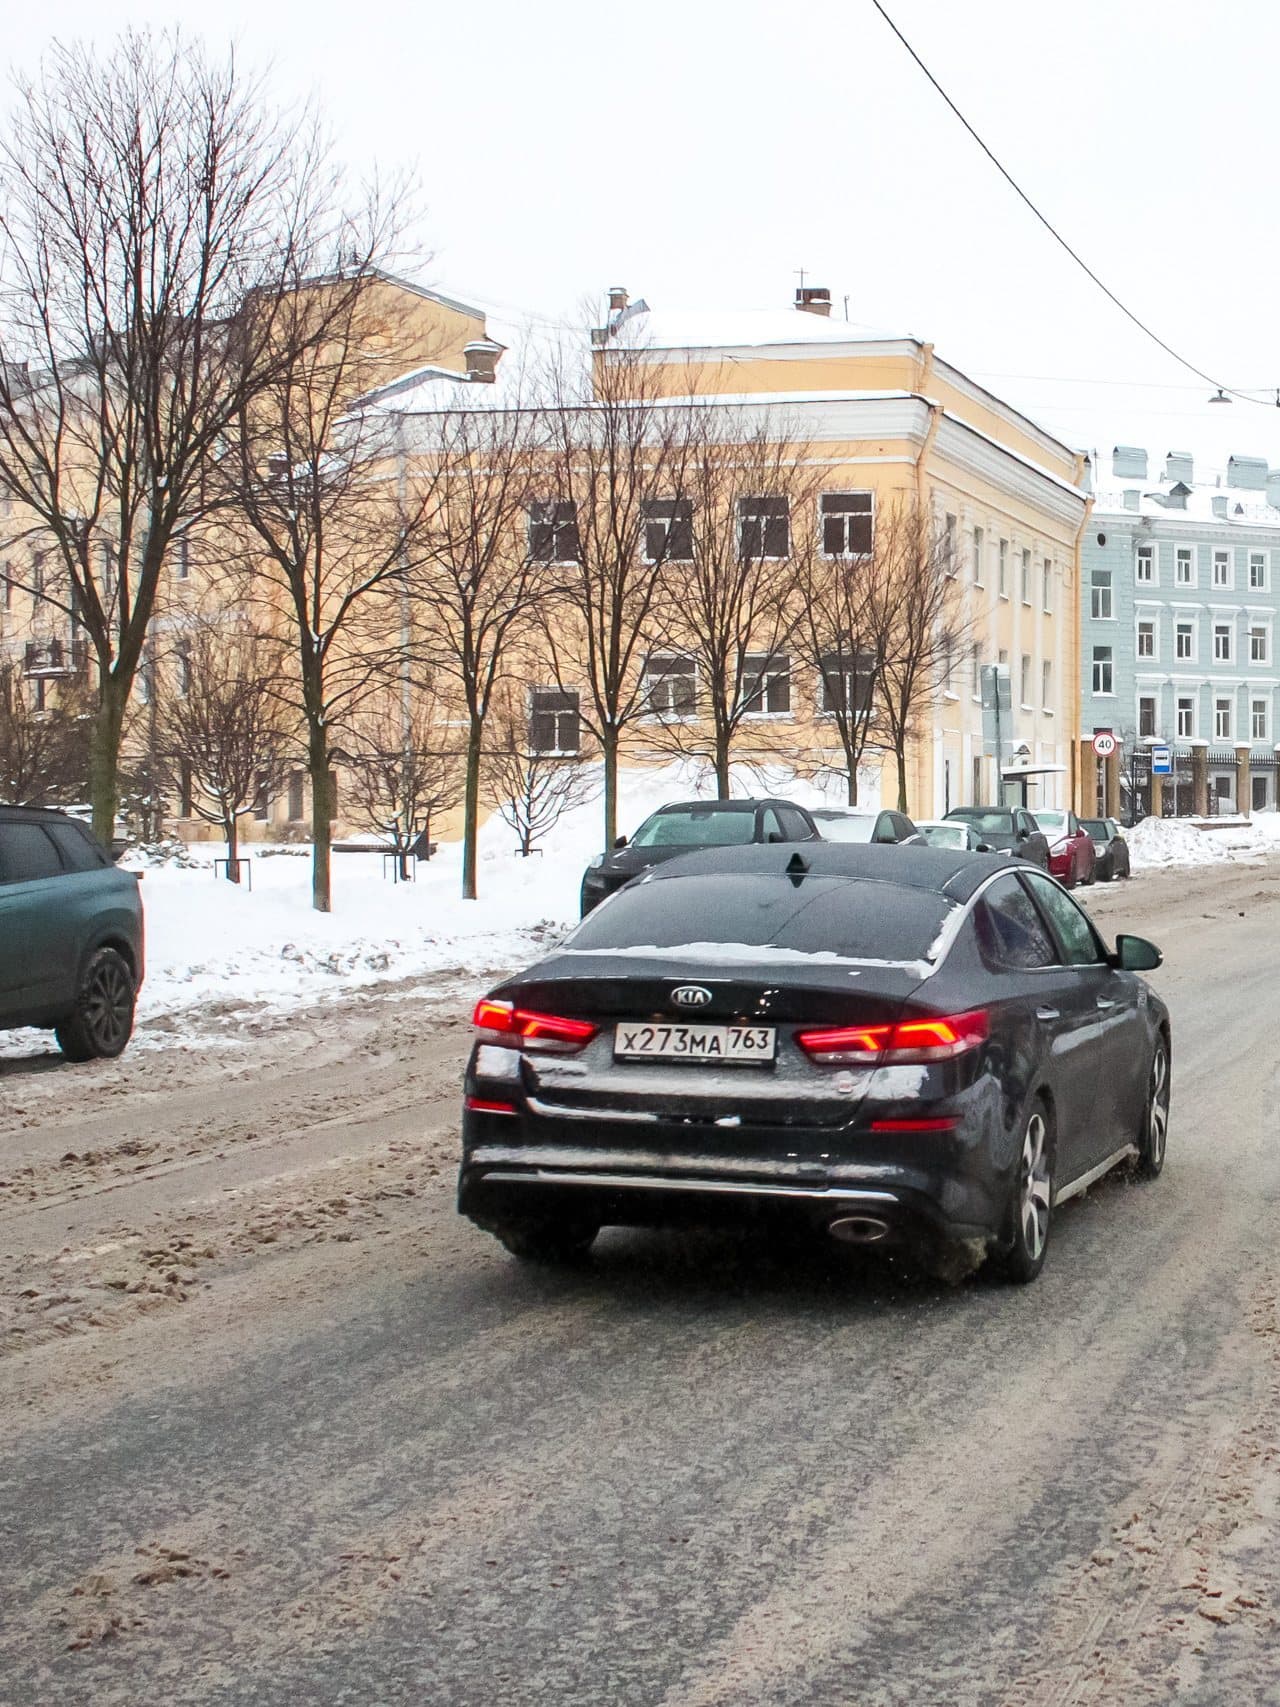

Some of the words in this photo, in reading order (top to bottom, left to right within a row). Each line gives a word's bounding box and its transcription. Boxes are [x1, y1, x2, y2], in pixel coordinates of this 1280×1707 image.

[1098, 739, 1112, 748] 40
[676, 990, 705, 1003] KIA
[730, 1029, 769, 1049] 763
